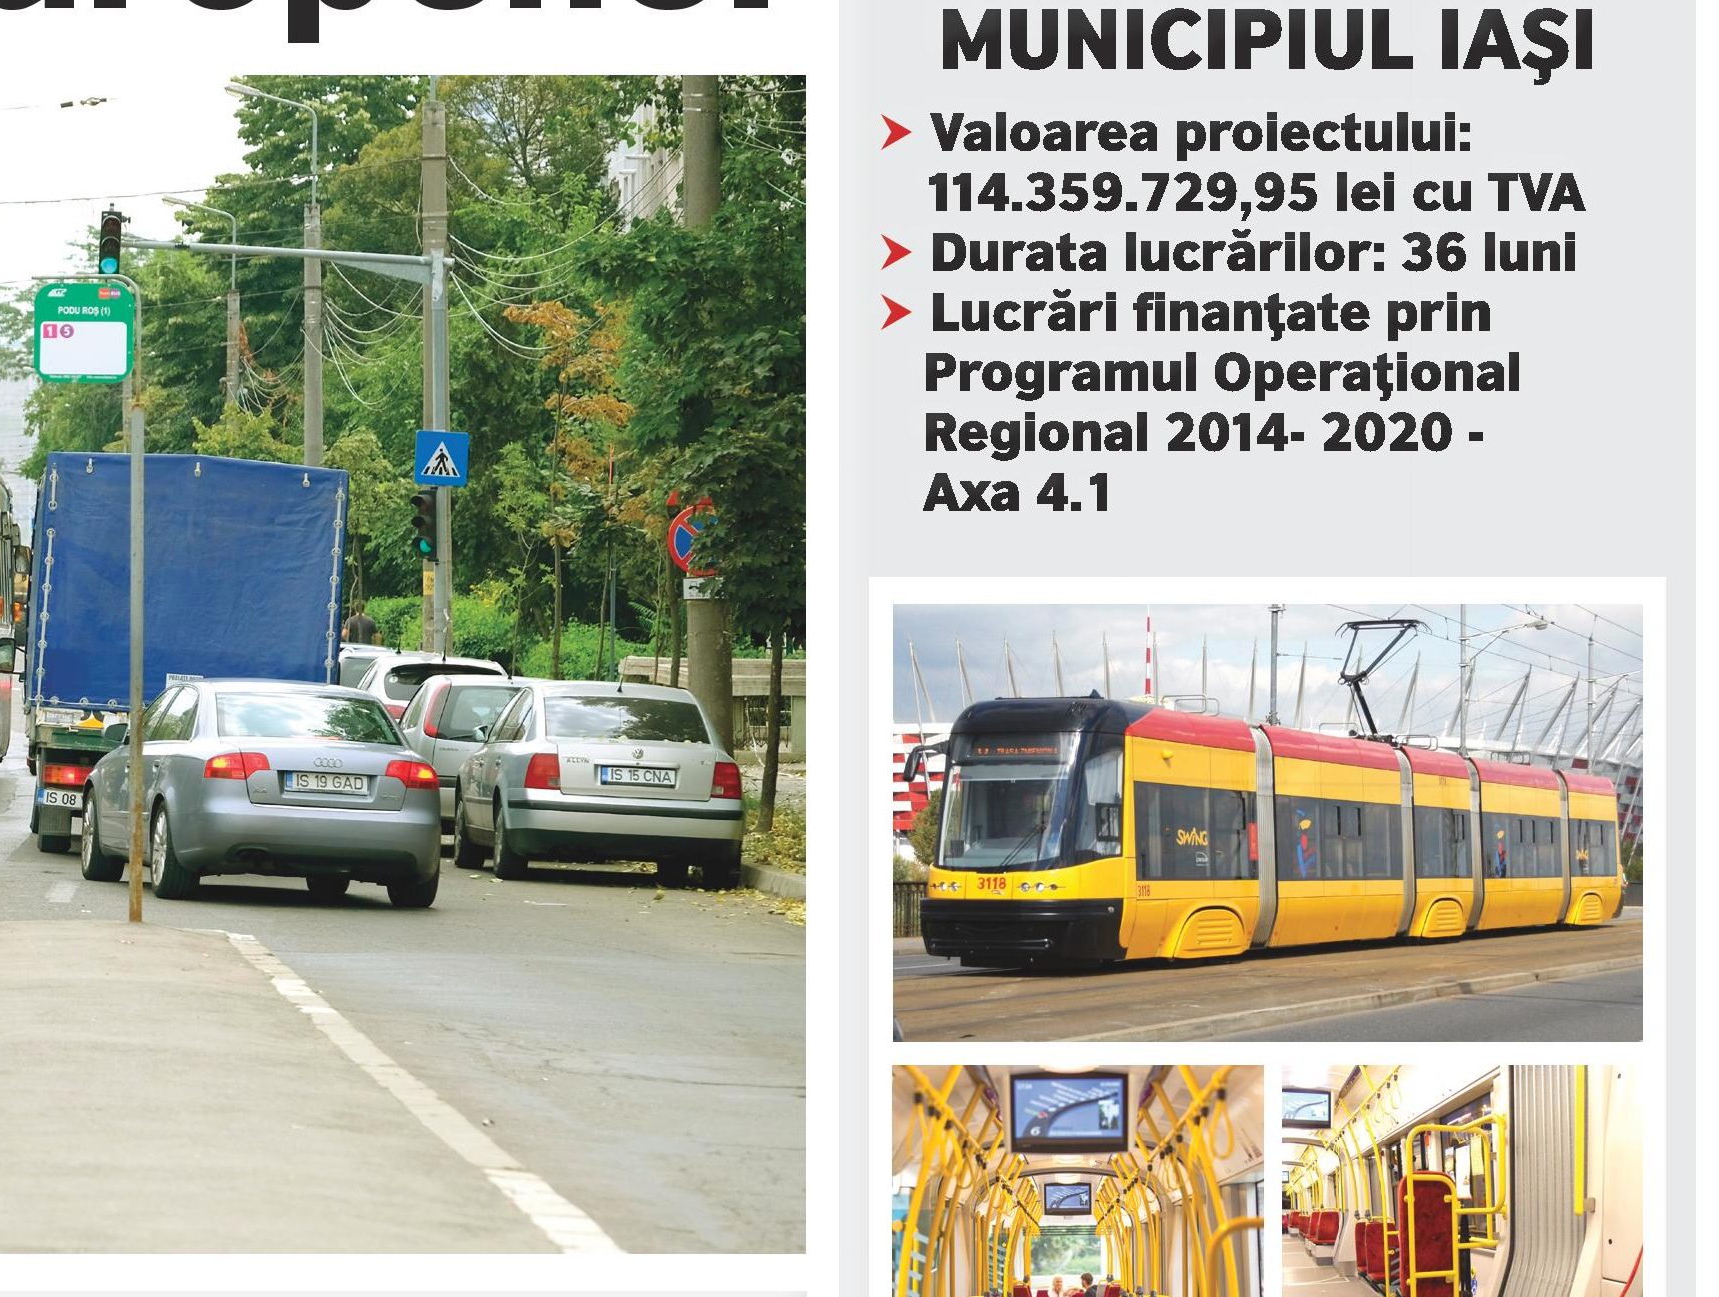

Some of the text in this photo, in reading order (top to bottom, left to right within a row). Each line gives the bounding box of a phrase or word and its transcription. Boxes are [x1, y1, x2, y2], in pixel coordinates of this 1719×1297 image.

[943, 8, 1413, 70] MUNICIPIUL
[930, 112, 1470, 161] Valoarea proiectului:
[929, 172, 1586, 221] 114.359.729,95 lei cu TVA
[933, 229, 1575, 272] Durata lucrărilor: 36 luni
[58, 306, 80, 314] PODU
[101, 306, 111, 316] (1)
[933, 290, 1116, 331] Lucrări
[1388, 292, 1490, 341] prin
[47, 326, 70, 336] 1 5
[926, 352, 1196, 401] Programul
[926, 412, 1147, 461] Regional
[1166, 412, 1304, 452] 2014-
[1322, 412, 1452, 452] 2020
[923, 473, 1107, 511] Axa 4.1
[296, 774, 364, 790] IS 19 GAD
[610, 769, 672, 783] IS 15 CNA
[46, 792, 77, 805] IS 08
[1176, 827, 1209, 846] SWING
[977, 877, 1006, 889] 3118
[1137, 885, 1151, 897] 3118
